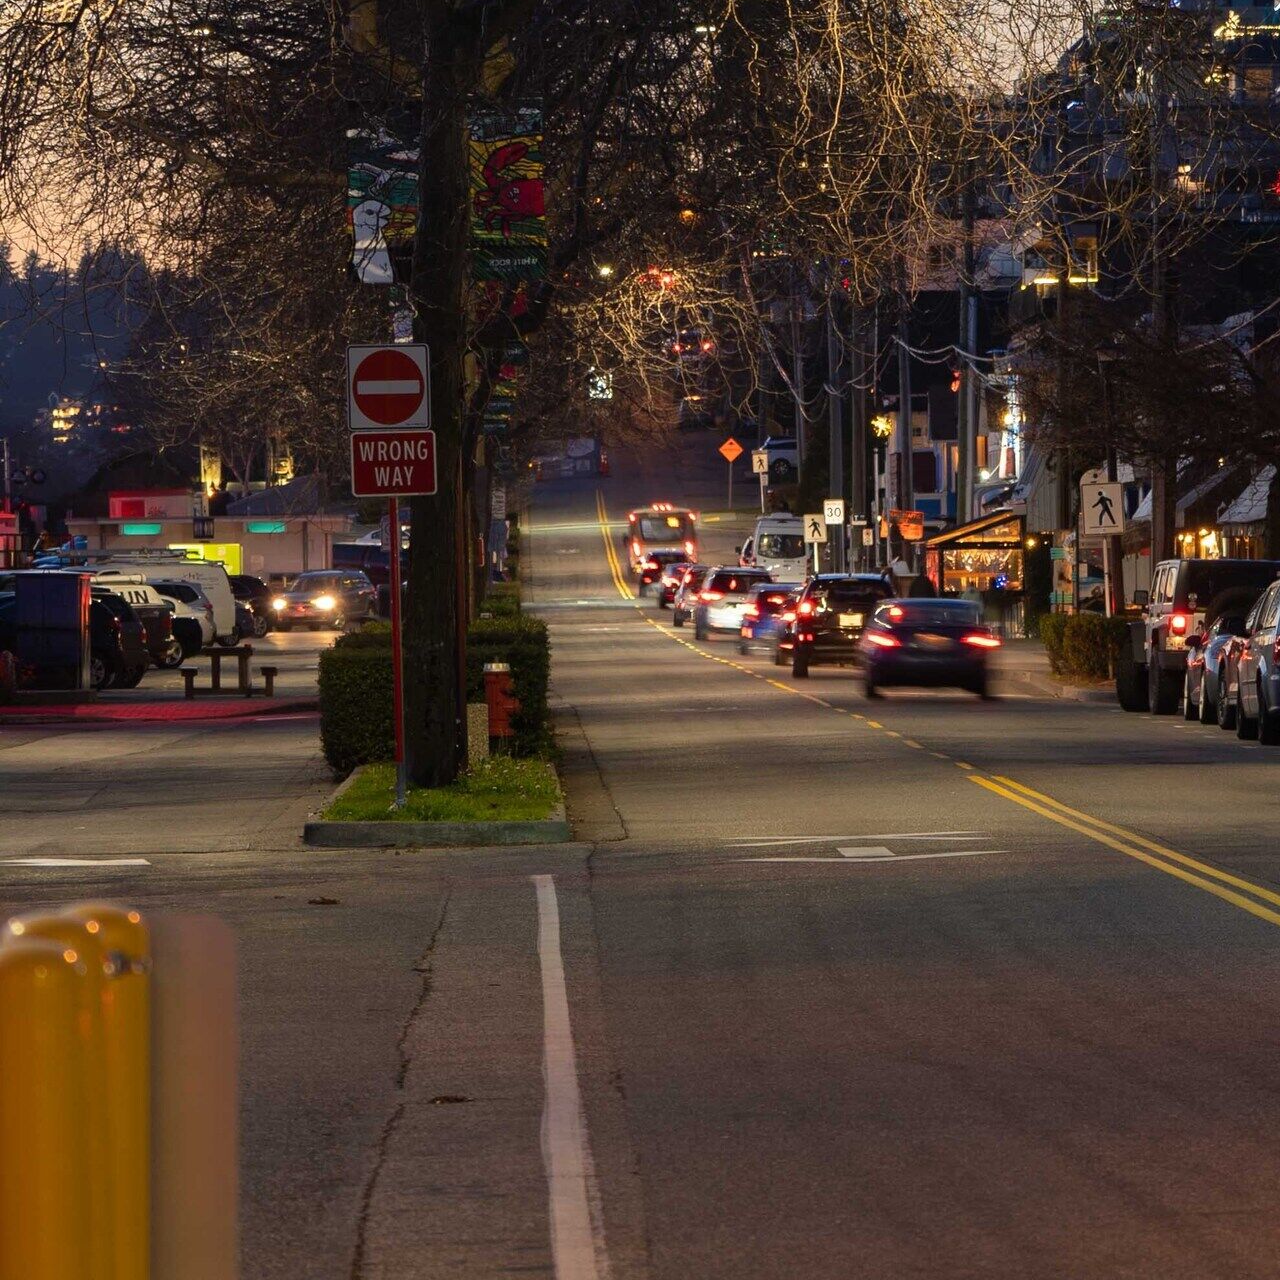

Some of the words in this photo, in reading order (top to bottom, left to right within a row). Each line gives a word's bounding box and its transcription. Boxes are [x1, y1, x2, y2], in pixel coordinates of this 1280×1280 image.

[359, 439, 429, 462] WRONG
[374, 466, 415, 487] WAY
[826, 507, 842, 518] 30
